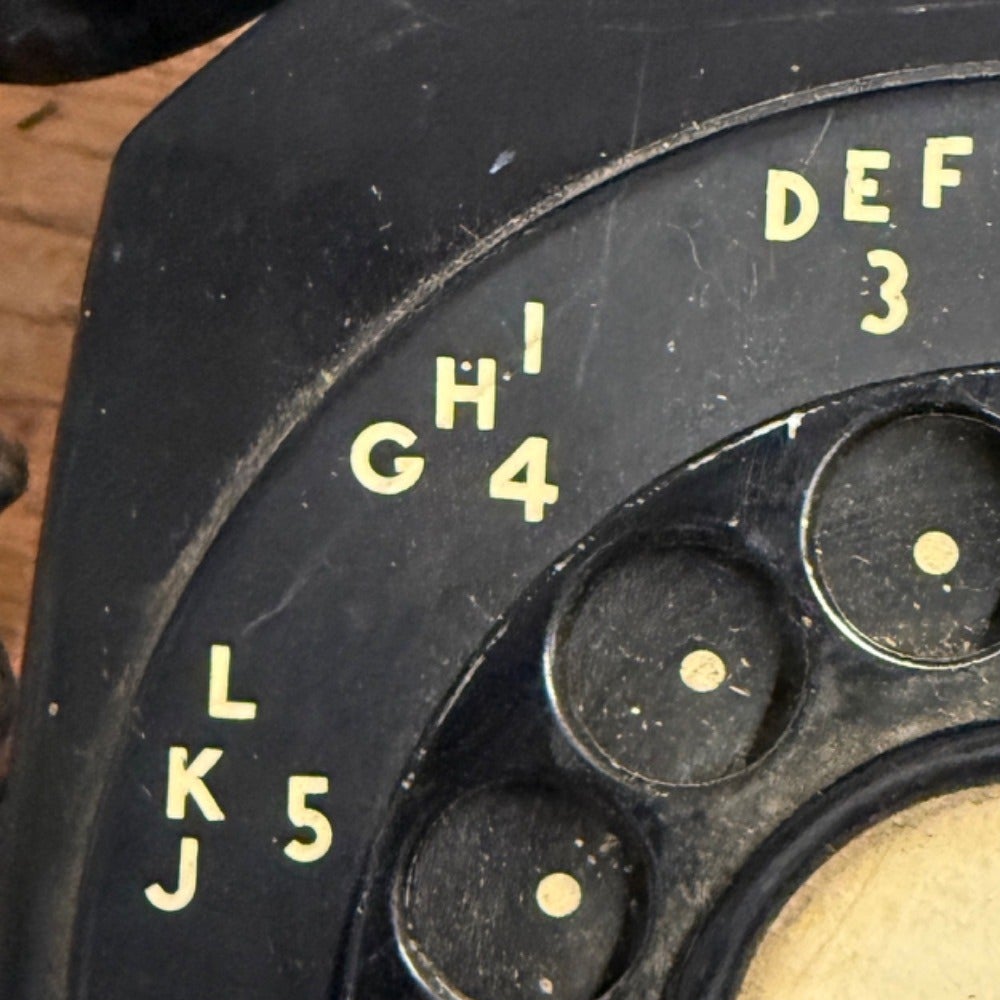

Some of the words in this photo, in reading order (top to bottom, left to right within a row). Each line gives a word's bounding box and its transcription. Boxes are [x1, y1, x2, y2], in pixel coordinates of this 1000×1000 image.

[766, 136, 974, 242] DEF
[862, 249, 909, 335] 3
[489, 436, 559, 522] 4
[285, 775, 333, 862] 5
